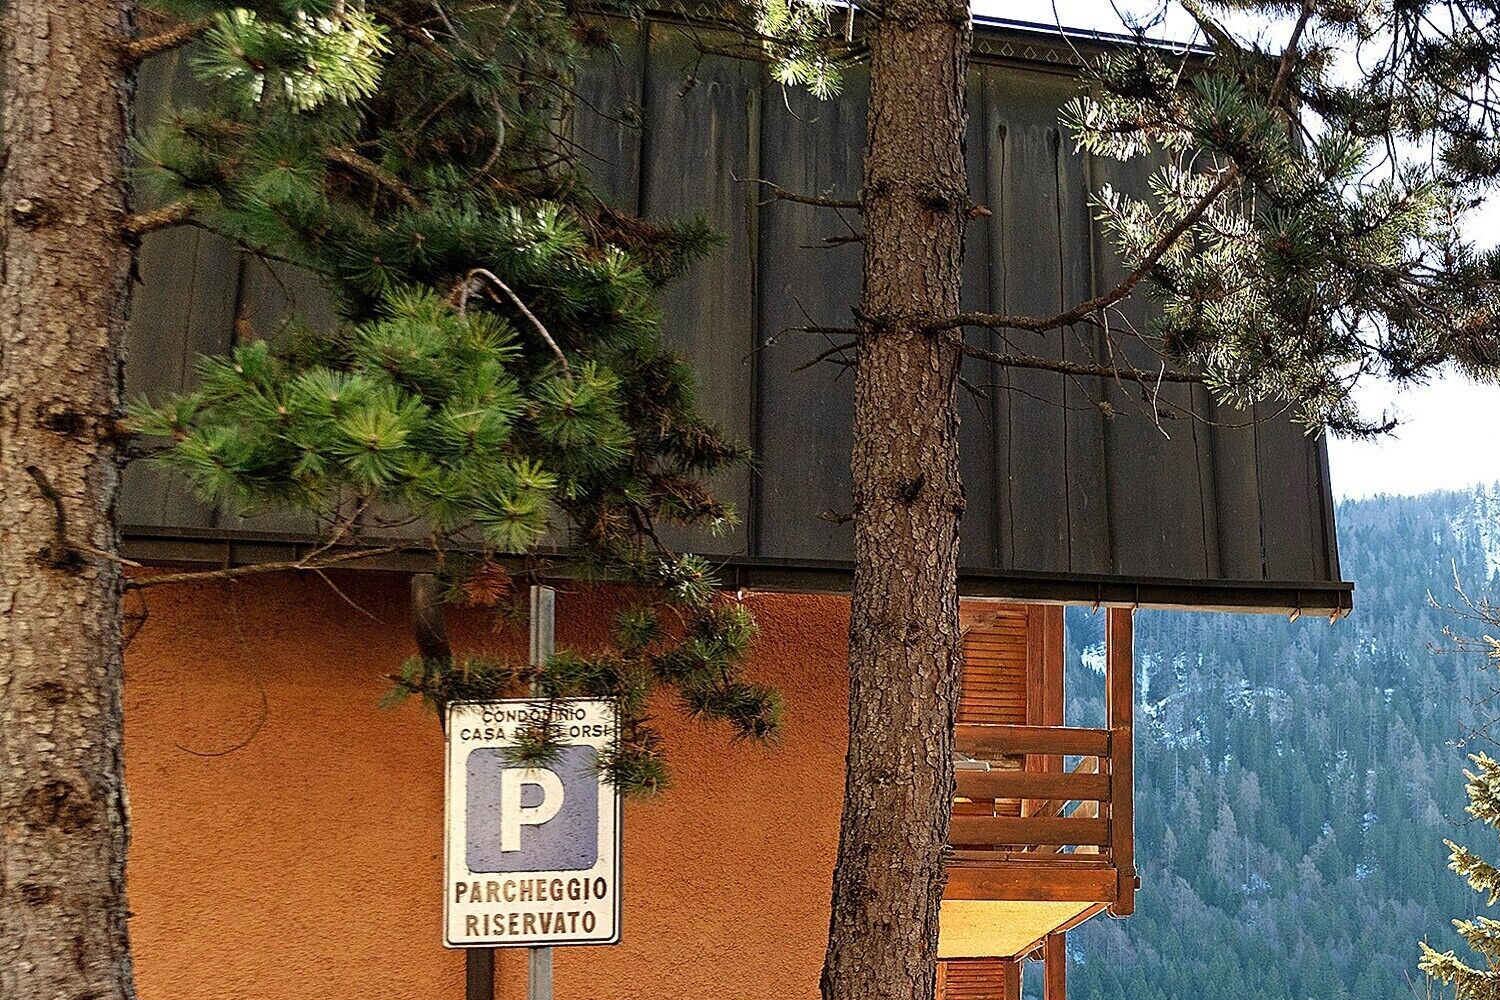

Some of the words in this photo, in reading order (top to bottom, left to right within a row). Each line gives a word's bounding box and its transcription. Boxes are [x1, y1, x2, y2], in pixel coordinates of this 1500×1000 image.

[460, 727, 507, 741] CASA
[501, 767, 565, 853] P
[455, 876, 608, 904] PARCHEGGIO
[465, 910, 596, 937] RISERVATO
